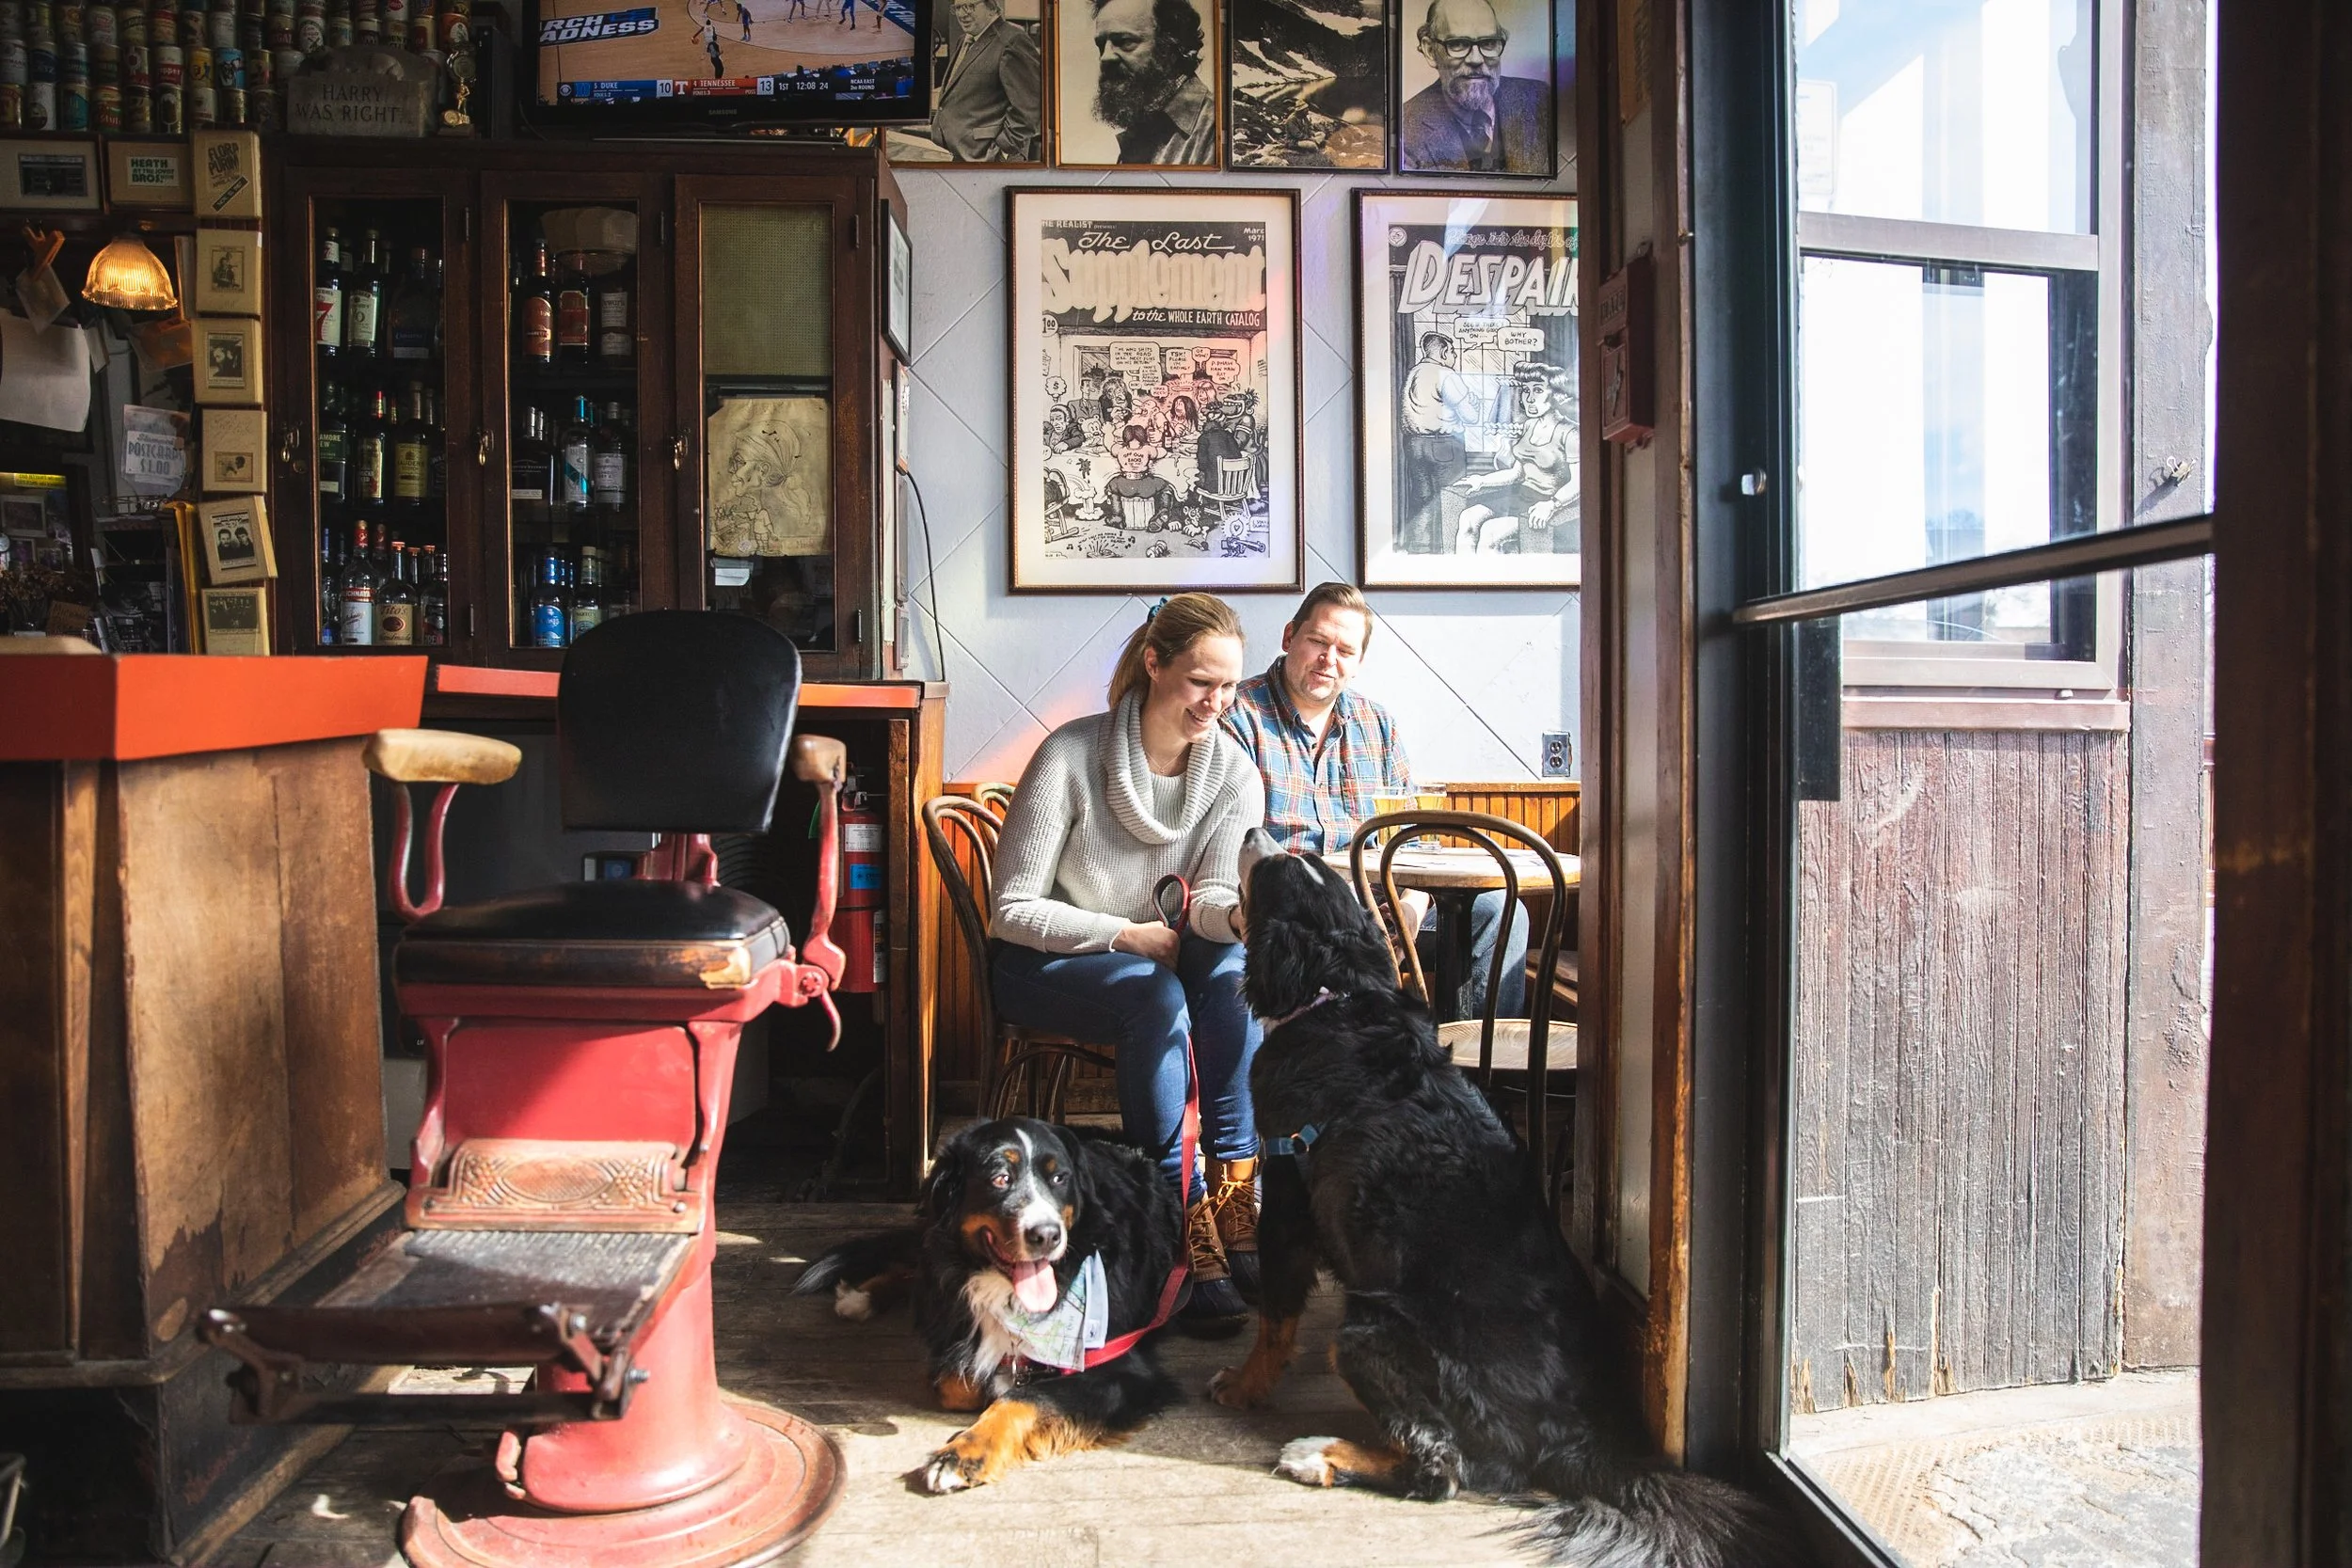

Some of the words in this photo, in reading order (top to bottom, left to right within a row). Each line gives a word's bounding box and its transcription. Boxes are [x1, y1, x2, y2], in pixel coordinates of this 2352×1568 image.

[544, 15, 605, 31] RCH
[659, 82, 672, 93] 10
[701, 79, 736, 87] TENNESSEE
[759, 81, 771, 91] 13
[778, 82, 789, 90] 1ST
[796, 82, 816, 90] 12:08
[819, 82, 829, 90] 24
[323, 84, 381, 103] HARRY
[295, 103, 334, 121] WAS
[208, 142, 240, 159] FLORA
[131, 158, 168, 168] HEATH
[208, 154, 240, 176] PURIM
[1057, 219, 1093, 230] REALIST
[1078, 231, 1130, 250] The
[1151, 230, 1235, 252] Last
[1248, 233, 1265, 243] 1971
[1041, 237, 1266, 324] Supplement
[1132, 309, 1148, 322] to
[1148, 310, 1167, 322] the
[1168, 310, 1194, 325] WHOLE
[1196, 311, 1222, 325] EARTH
[1225, 312, 1261, 327] CATALOG
[1504, 338, 1538, 346] BOTHER?
[140, 458, 170, 475] $1.00
[380, 605, 408, 616] Tito's
